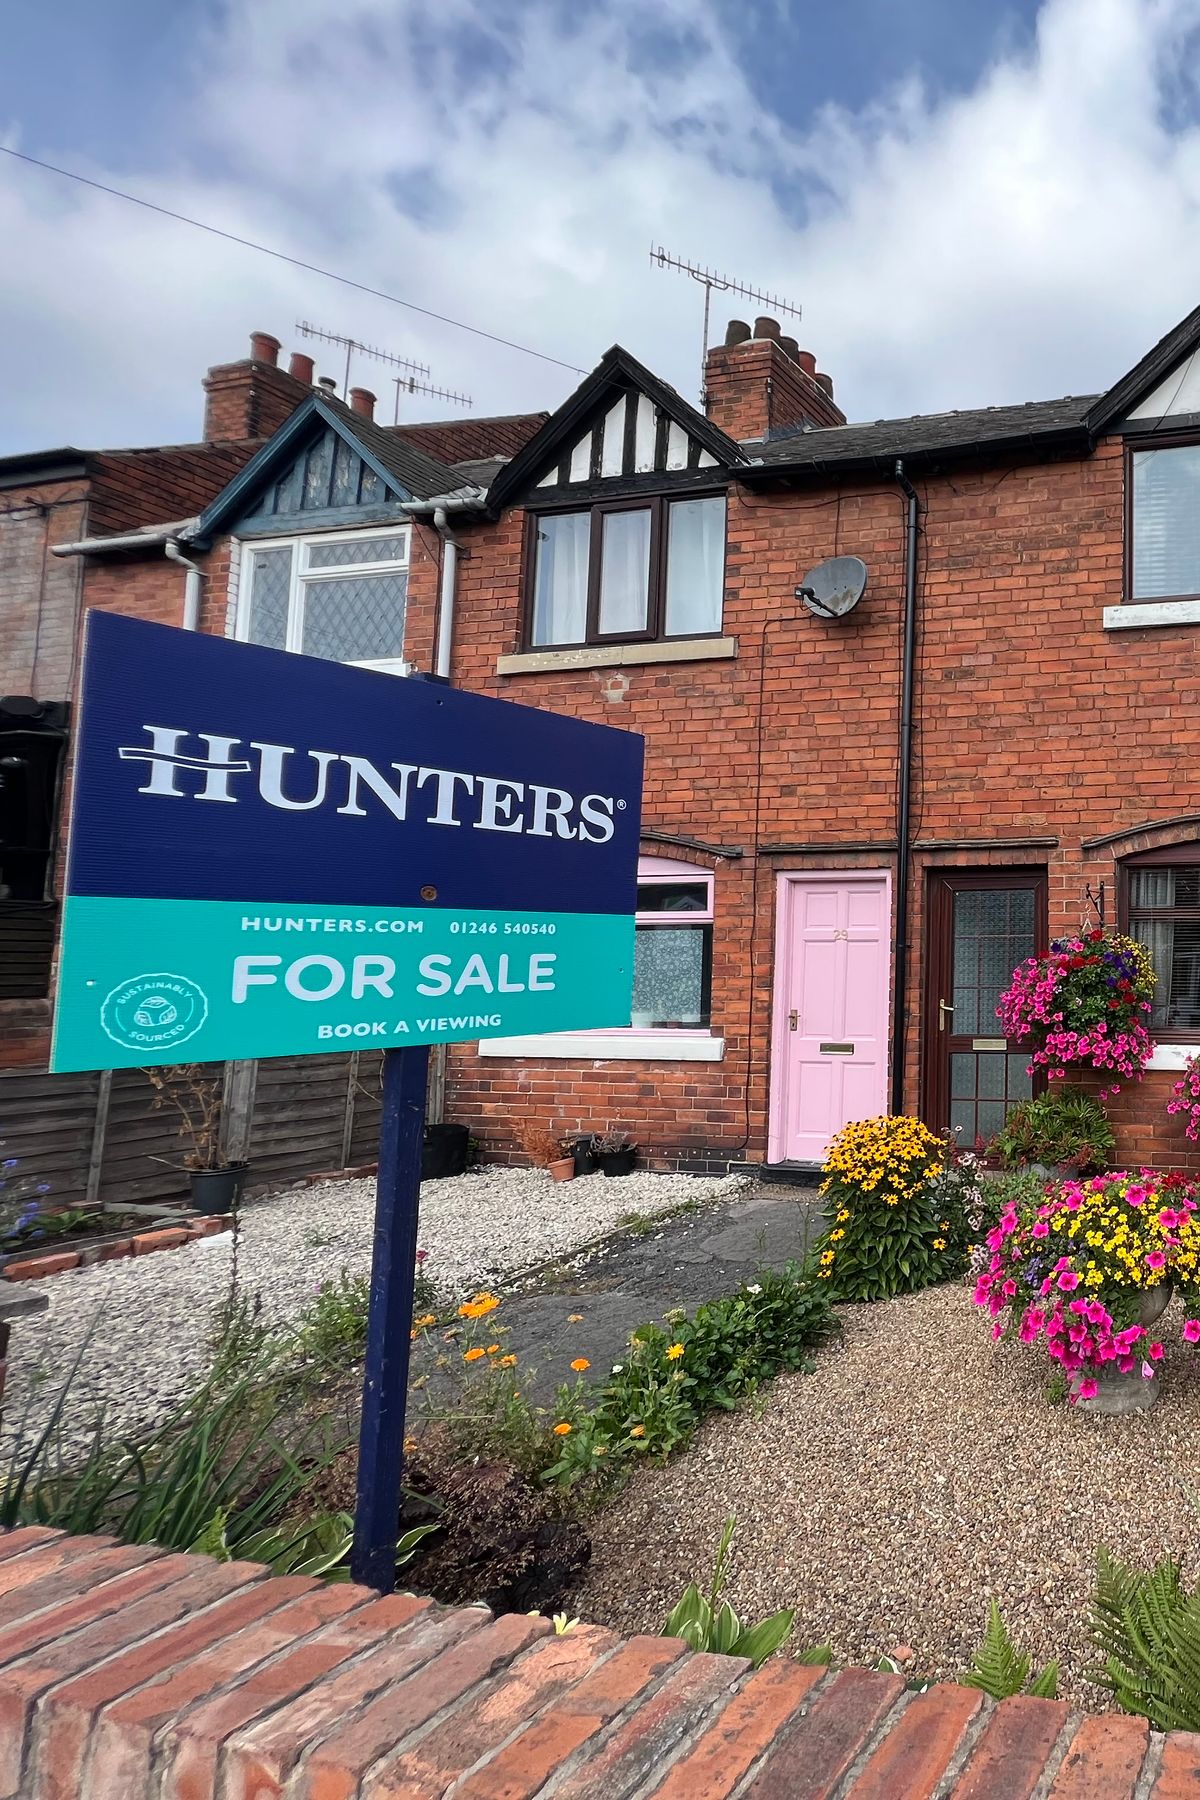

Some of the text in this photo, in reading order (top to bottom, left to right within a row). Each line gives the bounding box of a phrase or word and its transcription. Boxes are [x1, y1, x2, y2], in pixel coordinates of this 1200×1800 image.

[241, 916, 424, 934] HUNTERS.COM
[449, 921, 556, 936] 01246 540540
[832, 928, 849, 942] 29
[231, 953, 557, 1004] FOR SALE
[116, 981, 194, 1005] SUSTAINABLY
[128, 1024, 185, 1042] SOURCED
[317, 1013, 502, 1040] BOOK A VIEWING
